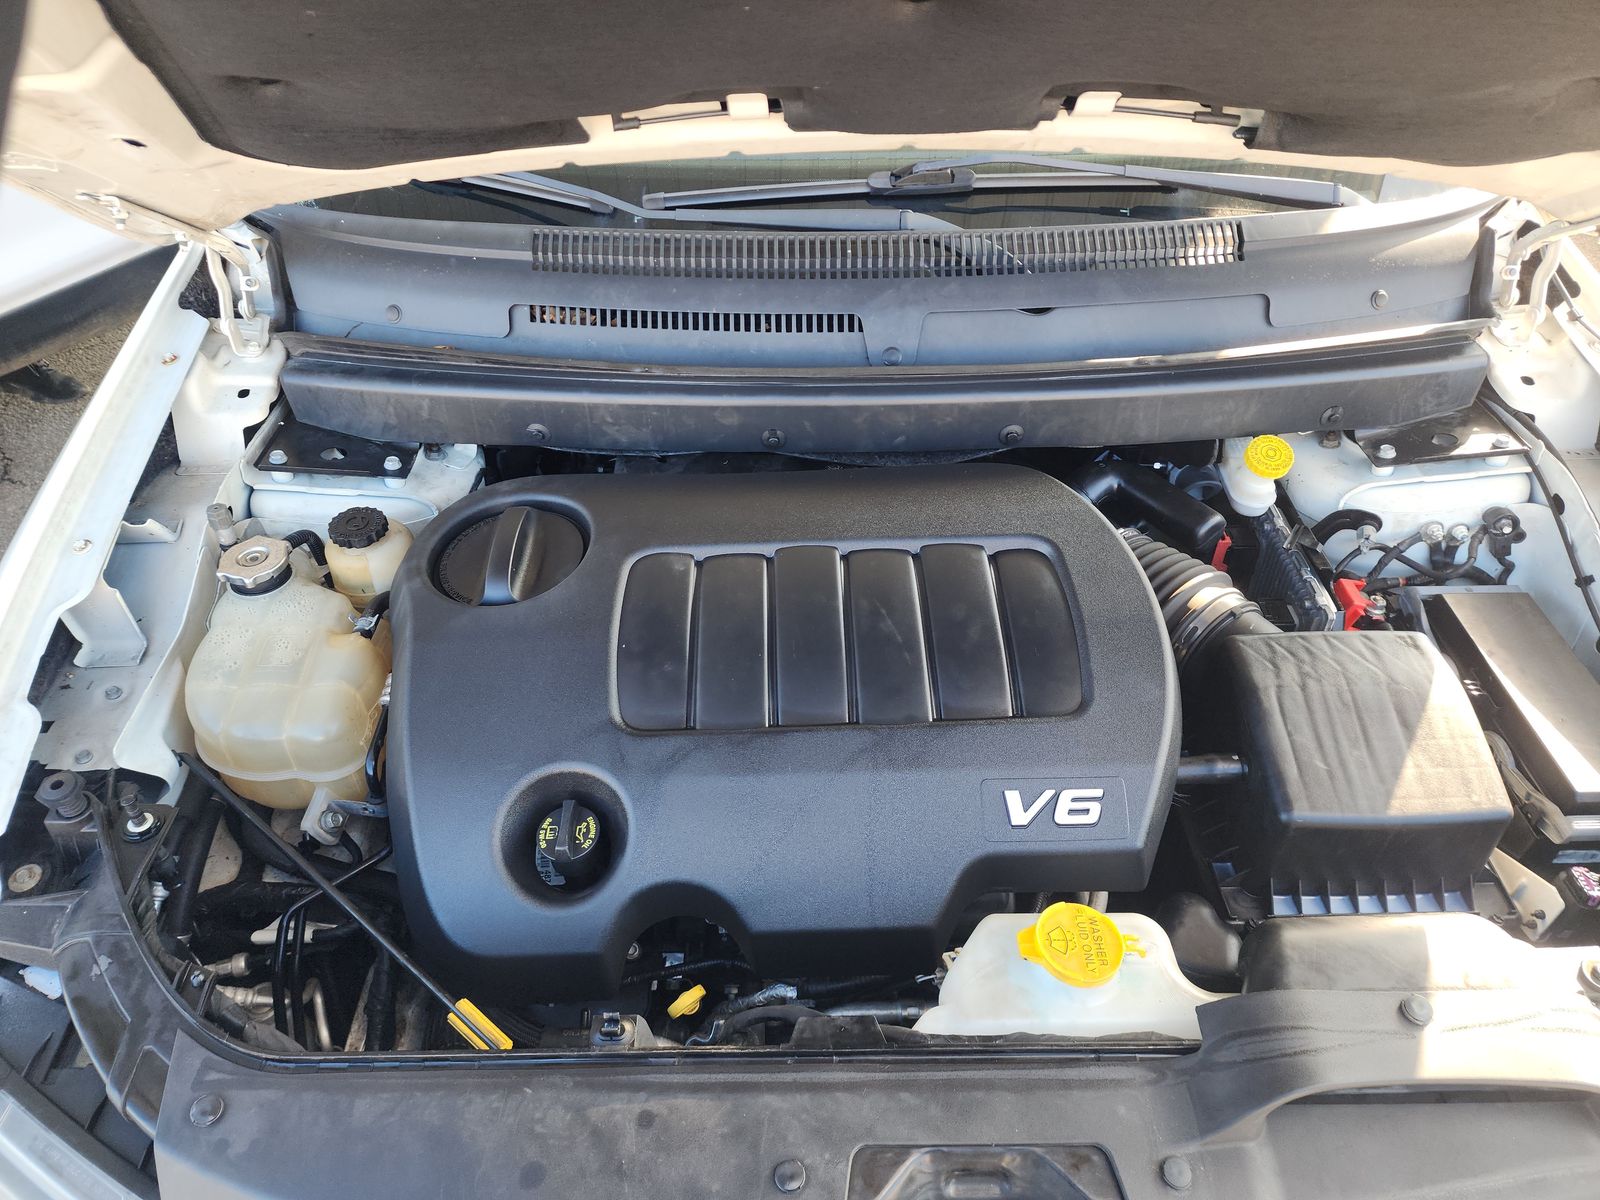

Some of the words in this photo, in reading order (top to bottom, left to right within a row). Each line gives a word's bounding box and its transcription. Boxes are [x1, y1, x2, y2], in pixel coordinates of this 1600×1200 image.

[1003, 788, 1105, 828] V6
[587, 816, 596, 839] ENGINE
[581, 839, 592, 849] OIL
[1074, 908, 1089, 941] FLUID
[1088, 916, 1109, 966] WASHER
[1081, 944, 1097, 974] ONLY
